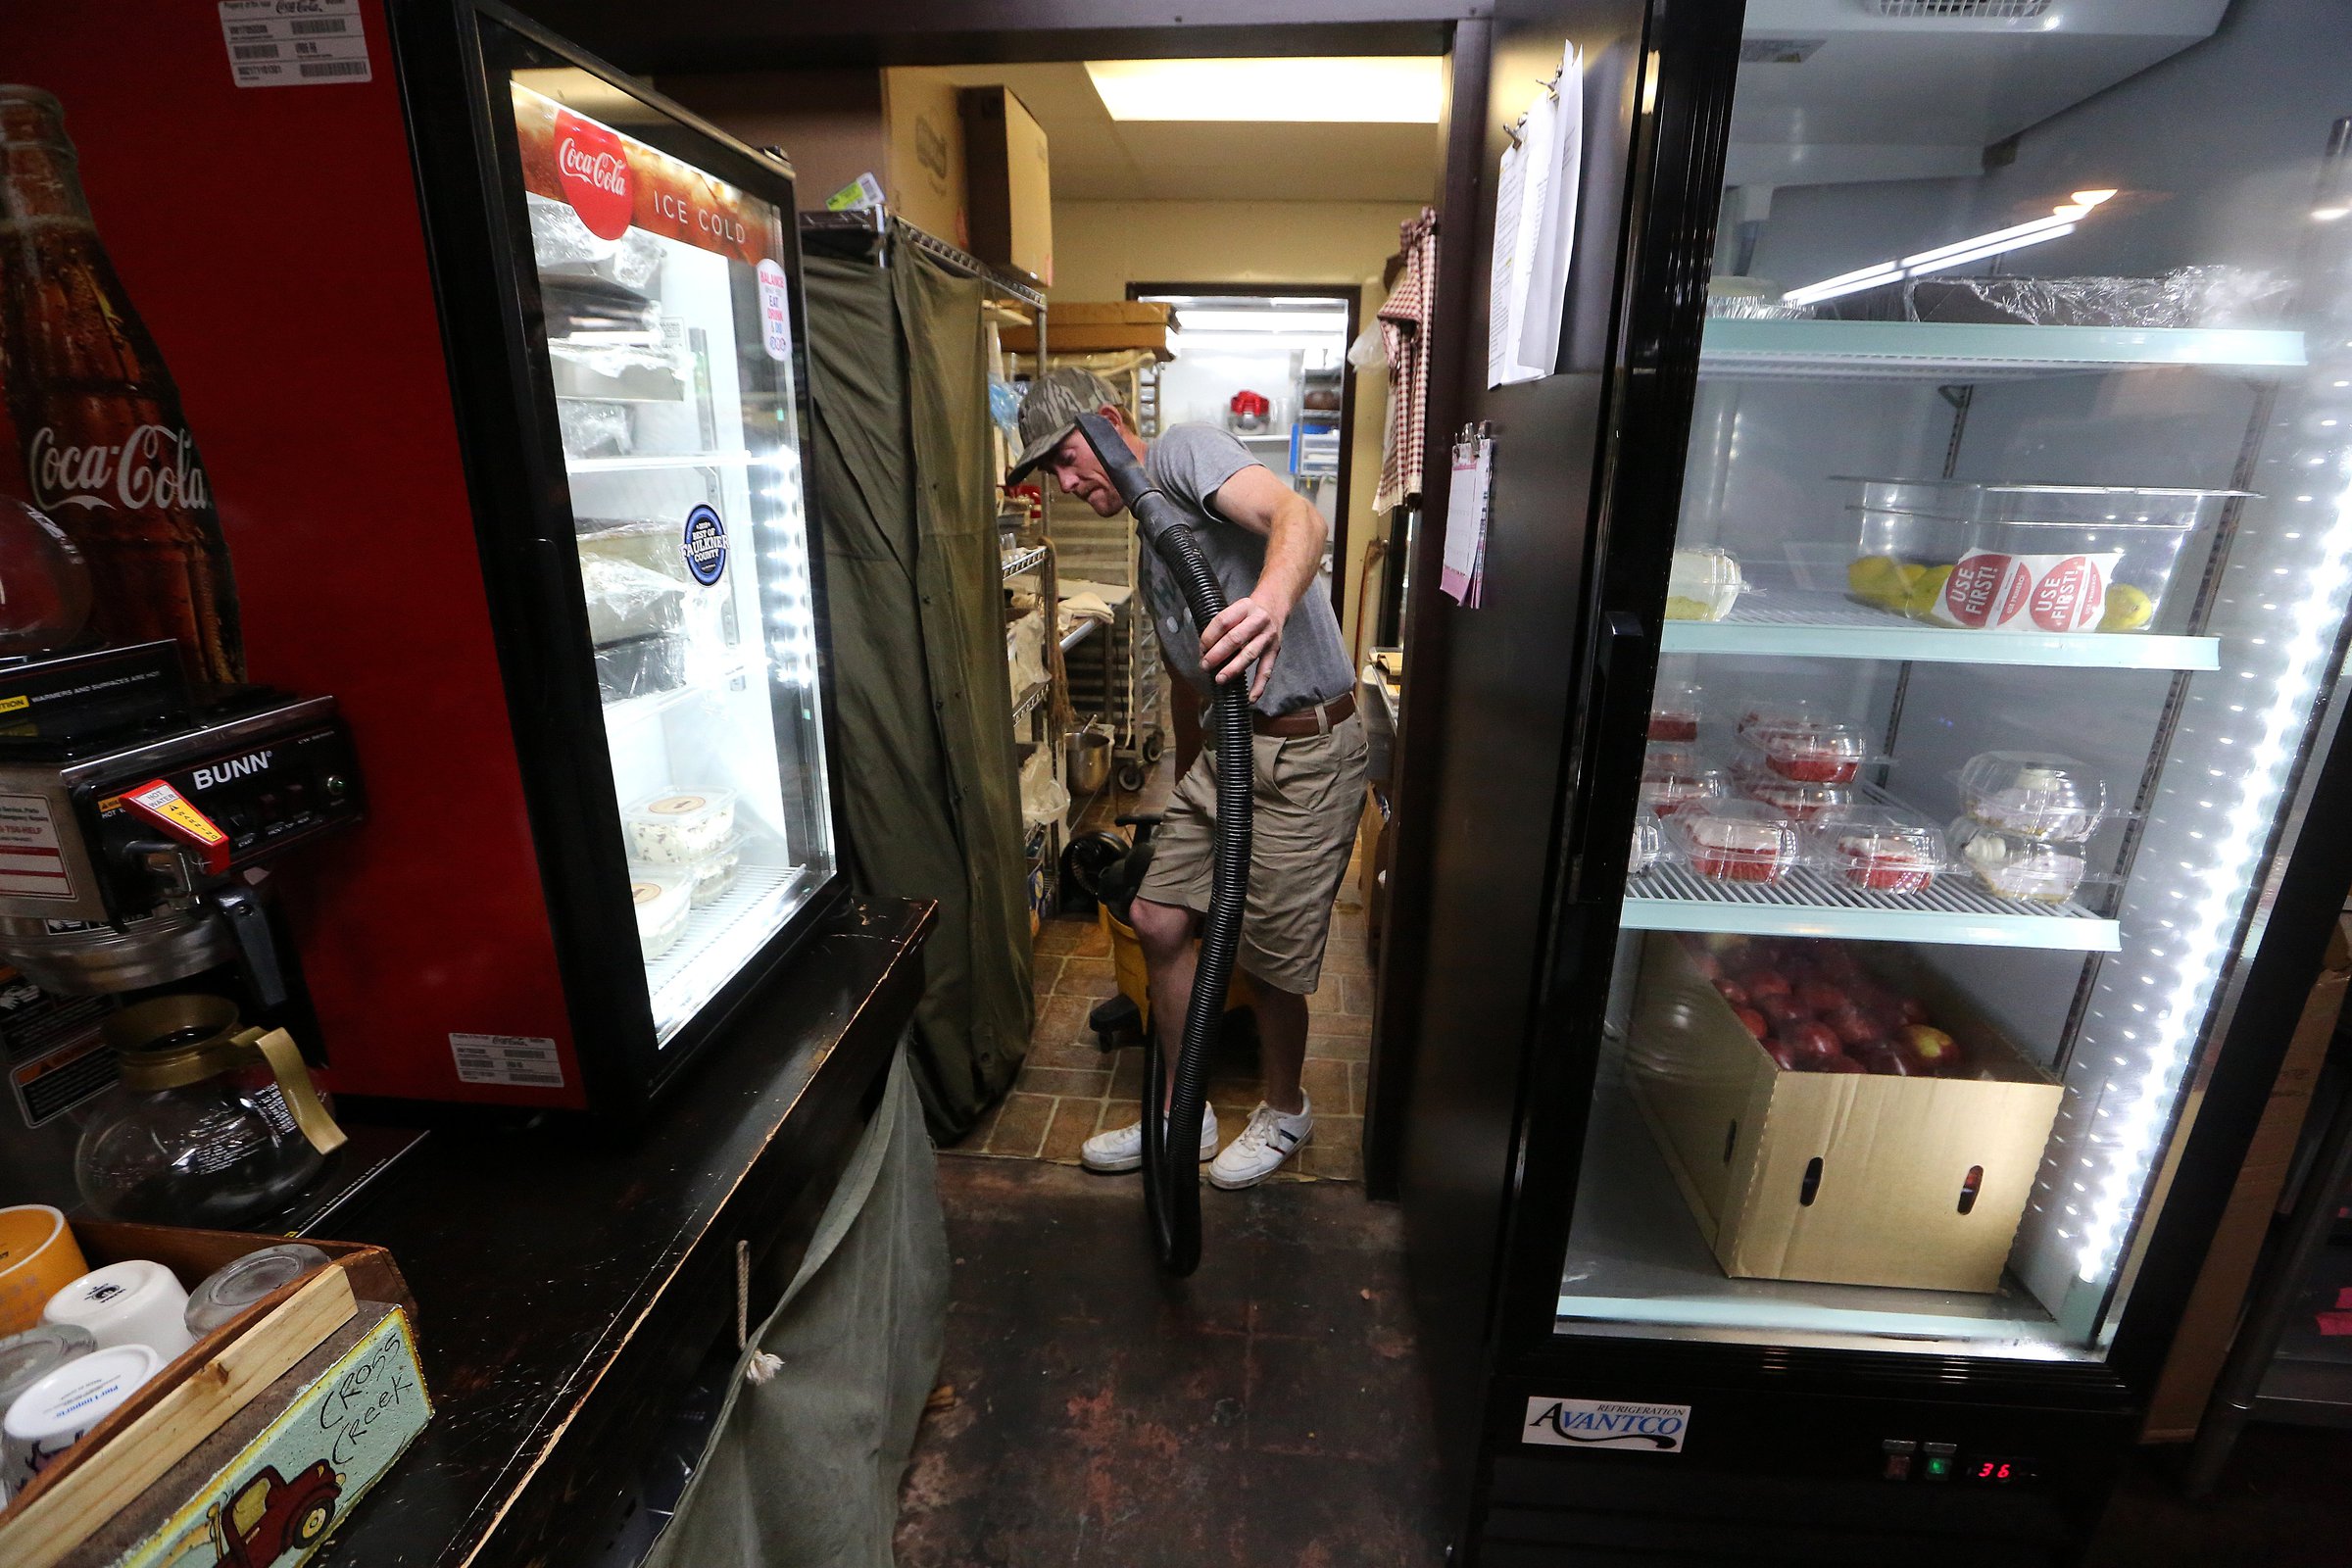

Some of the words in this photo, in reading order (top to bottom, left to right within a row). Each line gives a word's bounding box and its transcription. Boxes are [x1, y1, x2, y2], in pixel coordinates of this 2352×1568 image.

[560, 137, 626, 196] Coca-Cola
[654, 189, 688, 224] ICE
[698, 209, 745, 244] COLD
[30, 424, 208, 511] Coca-Cola
[679, 534, 730, 562] FAULKNER
[692, 530, 707, 540] BEST
[708, 527, 716, 536] OF
[694, 548, 719, 563] COUNTY
[1950, 568, 1975, 602] USE
[1965, 566, 1998, 614] FIRST!
[2035, 577, 2062, 612] USE
[2050, 570, 2079, 619] FIRST!
[193, 751, 270, 790] BUNN
[147, 790, 163, 801] HOT
[149, 794, 175, 808] WATER
[1596, 1403, 1687, 1416] REFRIGERATION
[1978, 1462, 2011, 1478] 36
